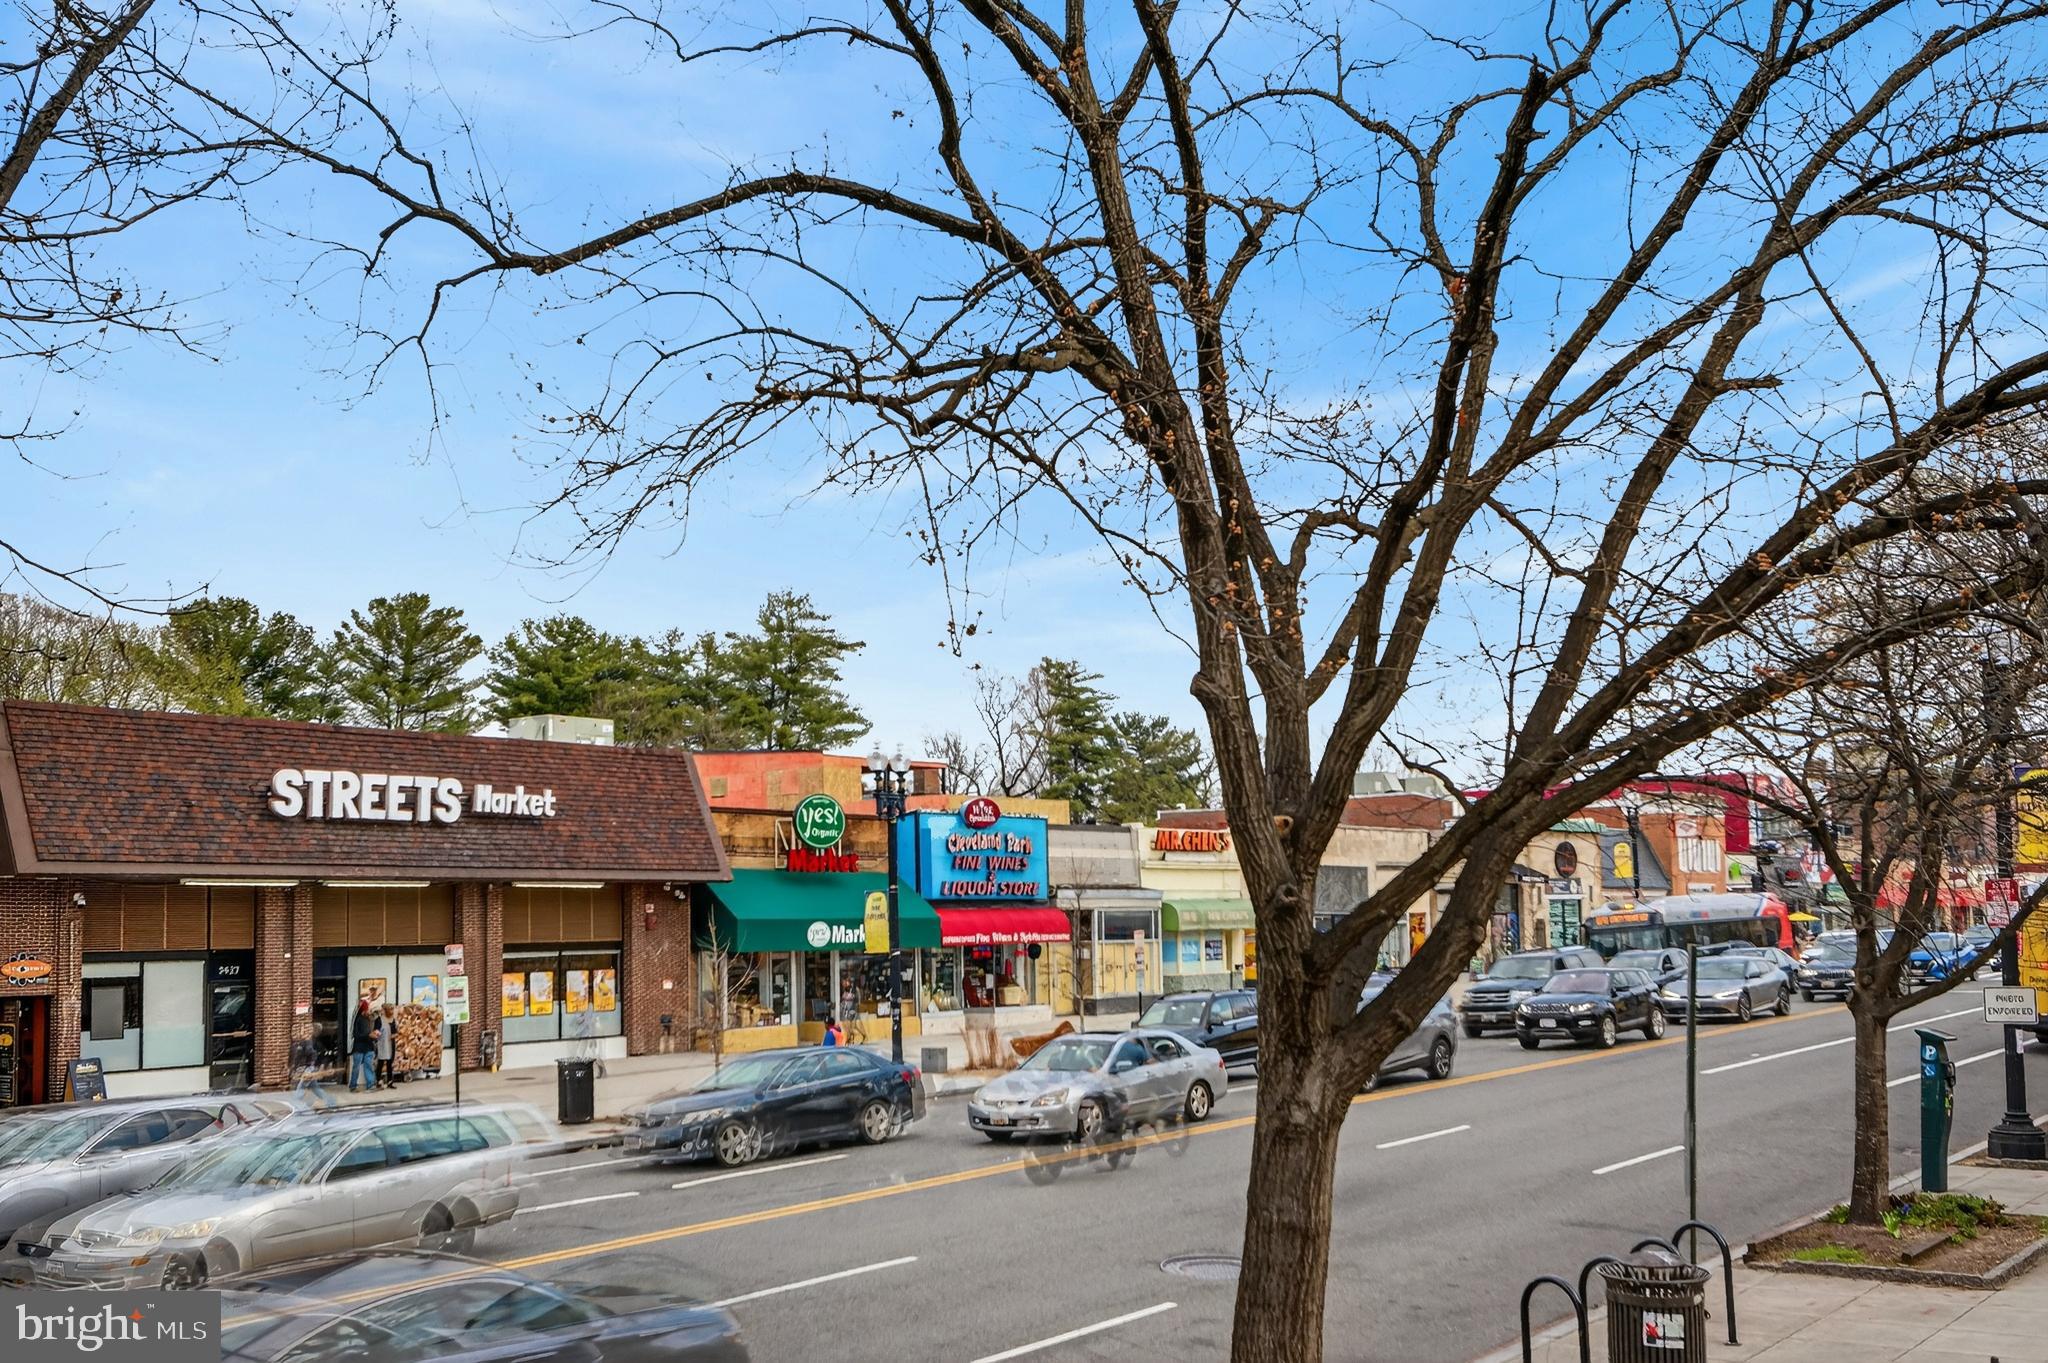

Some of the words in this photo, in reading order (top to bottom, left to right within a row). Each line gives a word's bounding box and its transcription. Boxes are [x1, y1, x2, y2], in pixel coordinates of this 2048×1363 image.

[270, 768, 463, 824] STREETS
[473, 784, 556, 817] Market
[801, 805, 838, 839] yes!
[812, 828, 839, 838] Organic
[948, 831, 1002, 853] Cleveland
[1006, 832, 1033, 854] Park
[786, 848, 860, 873] Market
[953, 856, 981, 870] FINE
[988, 856, 1029, 870] WINES
[943, 881, 997, 898] LIQUOR
[1000, 882, 1040, 897] STORE
[832, 925, 866, 944] Mark
[1995, 994, 2025, 1003] PHOTO
[1987, 1007, 2034, 1016] ENFORCED
[1925, 1045, 1937, 1060] P
